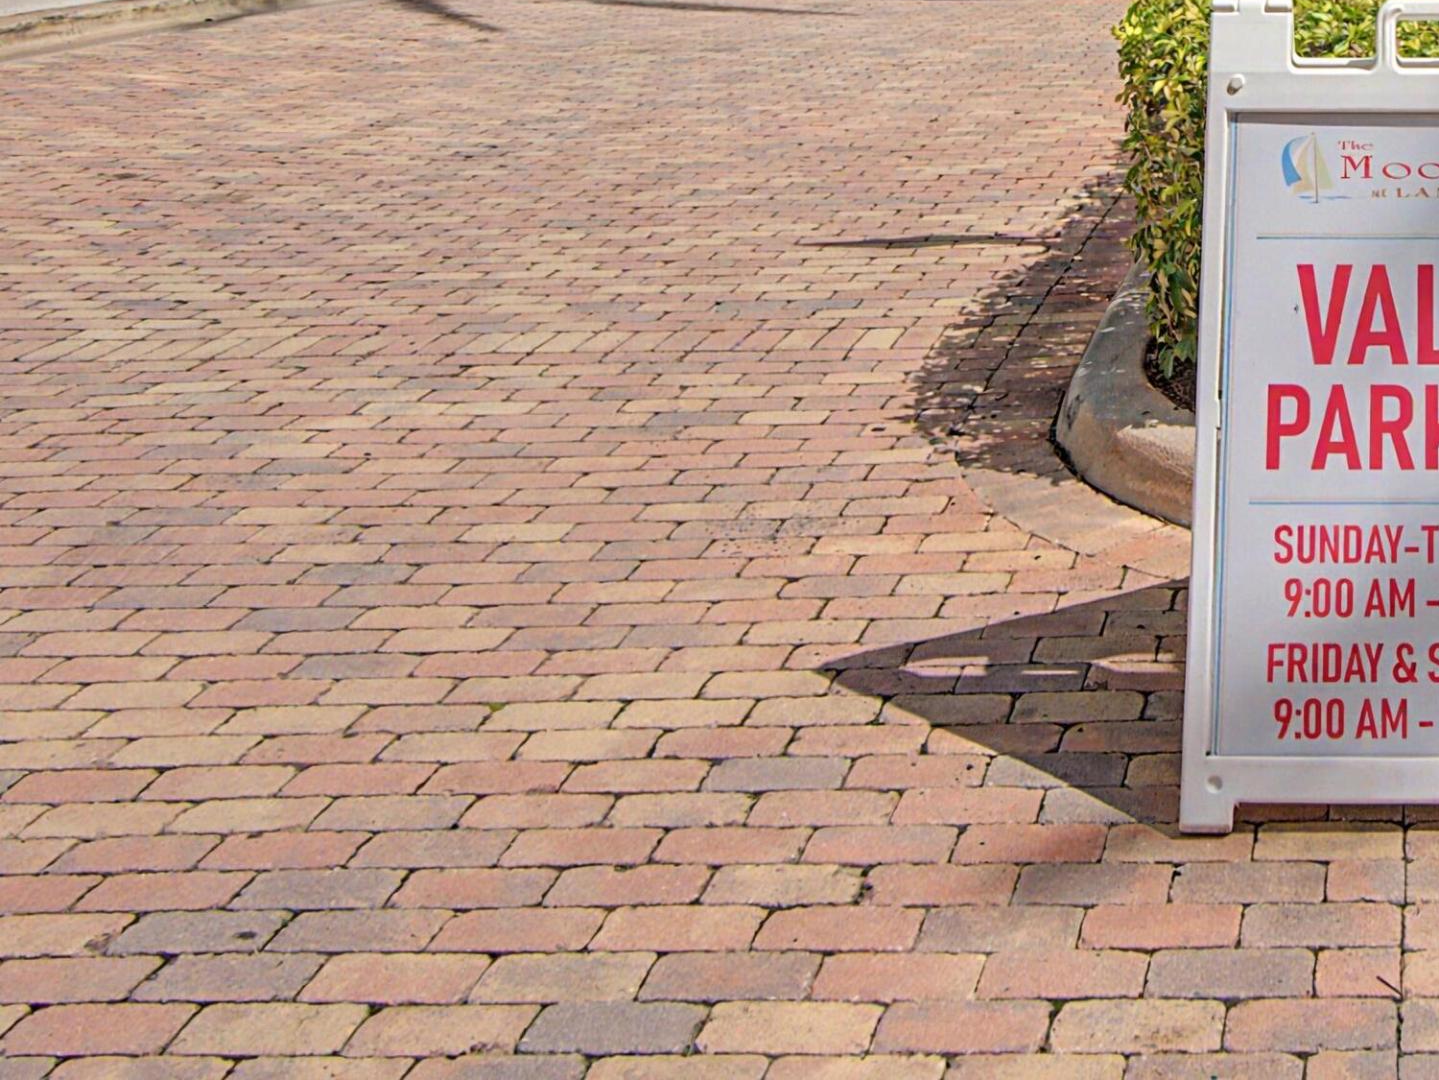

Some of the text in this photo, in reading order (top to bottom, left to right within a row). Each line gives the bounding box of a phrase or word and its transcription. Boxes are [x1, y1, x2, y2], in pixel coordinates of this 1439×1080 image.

[1337, 140, 1373, 150] The
[1283, 578, 1354, 618] 9:00
[1363, 578, 1416, 618] AM
[1266, 642, 1384, 684] FRIDAY
[1392, 642, 1418, 684] &
[1273, 698, 1345, 740] 9:00
[1355, 698, 1409, 740] AM
